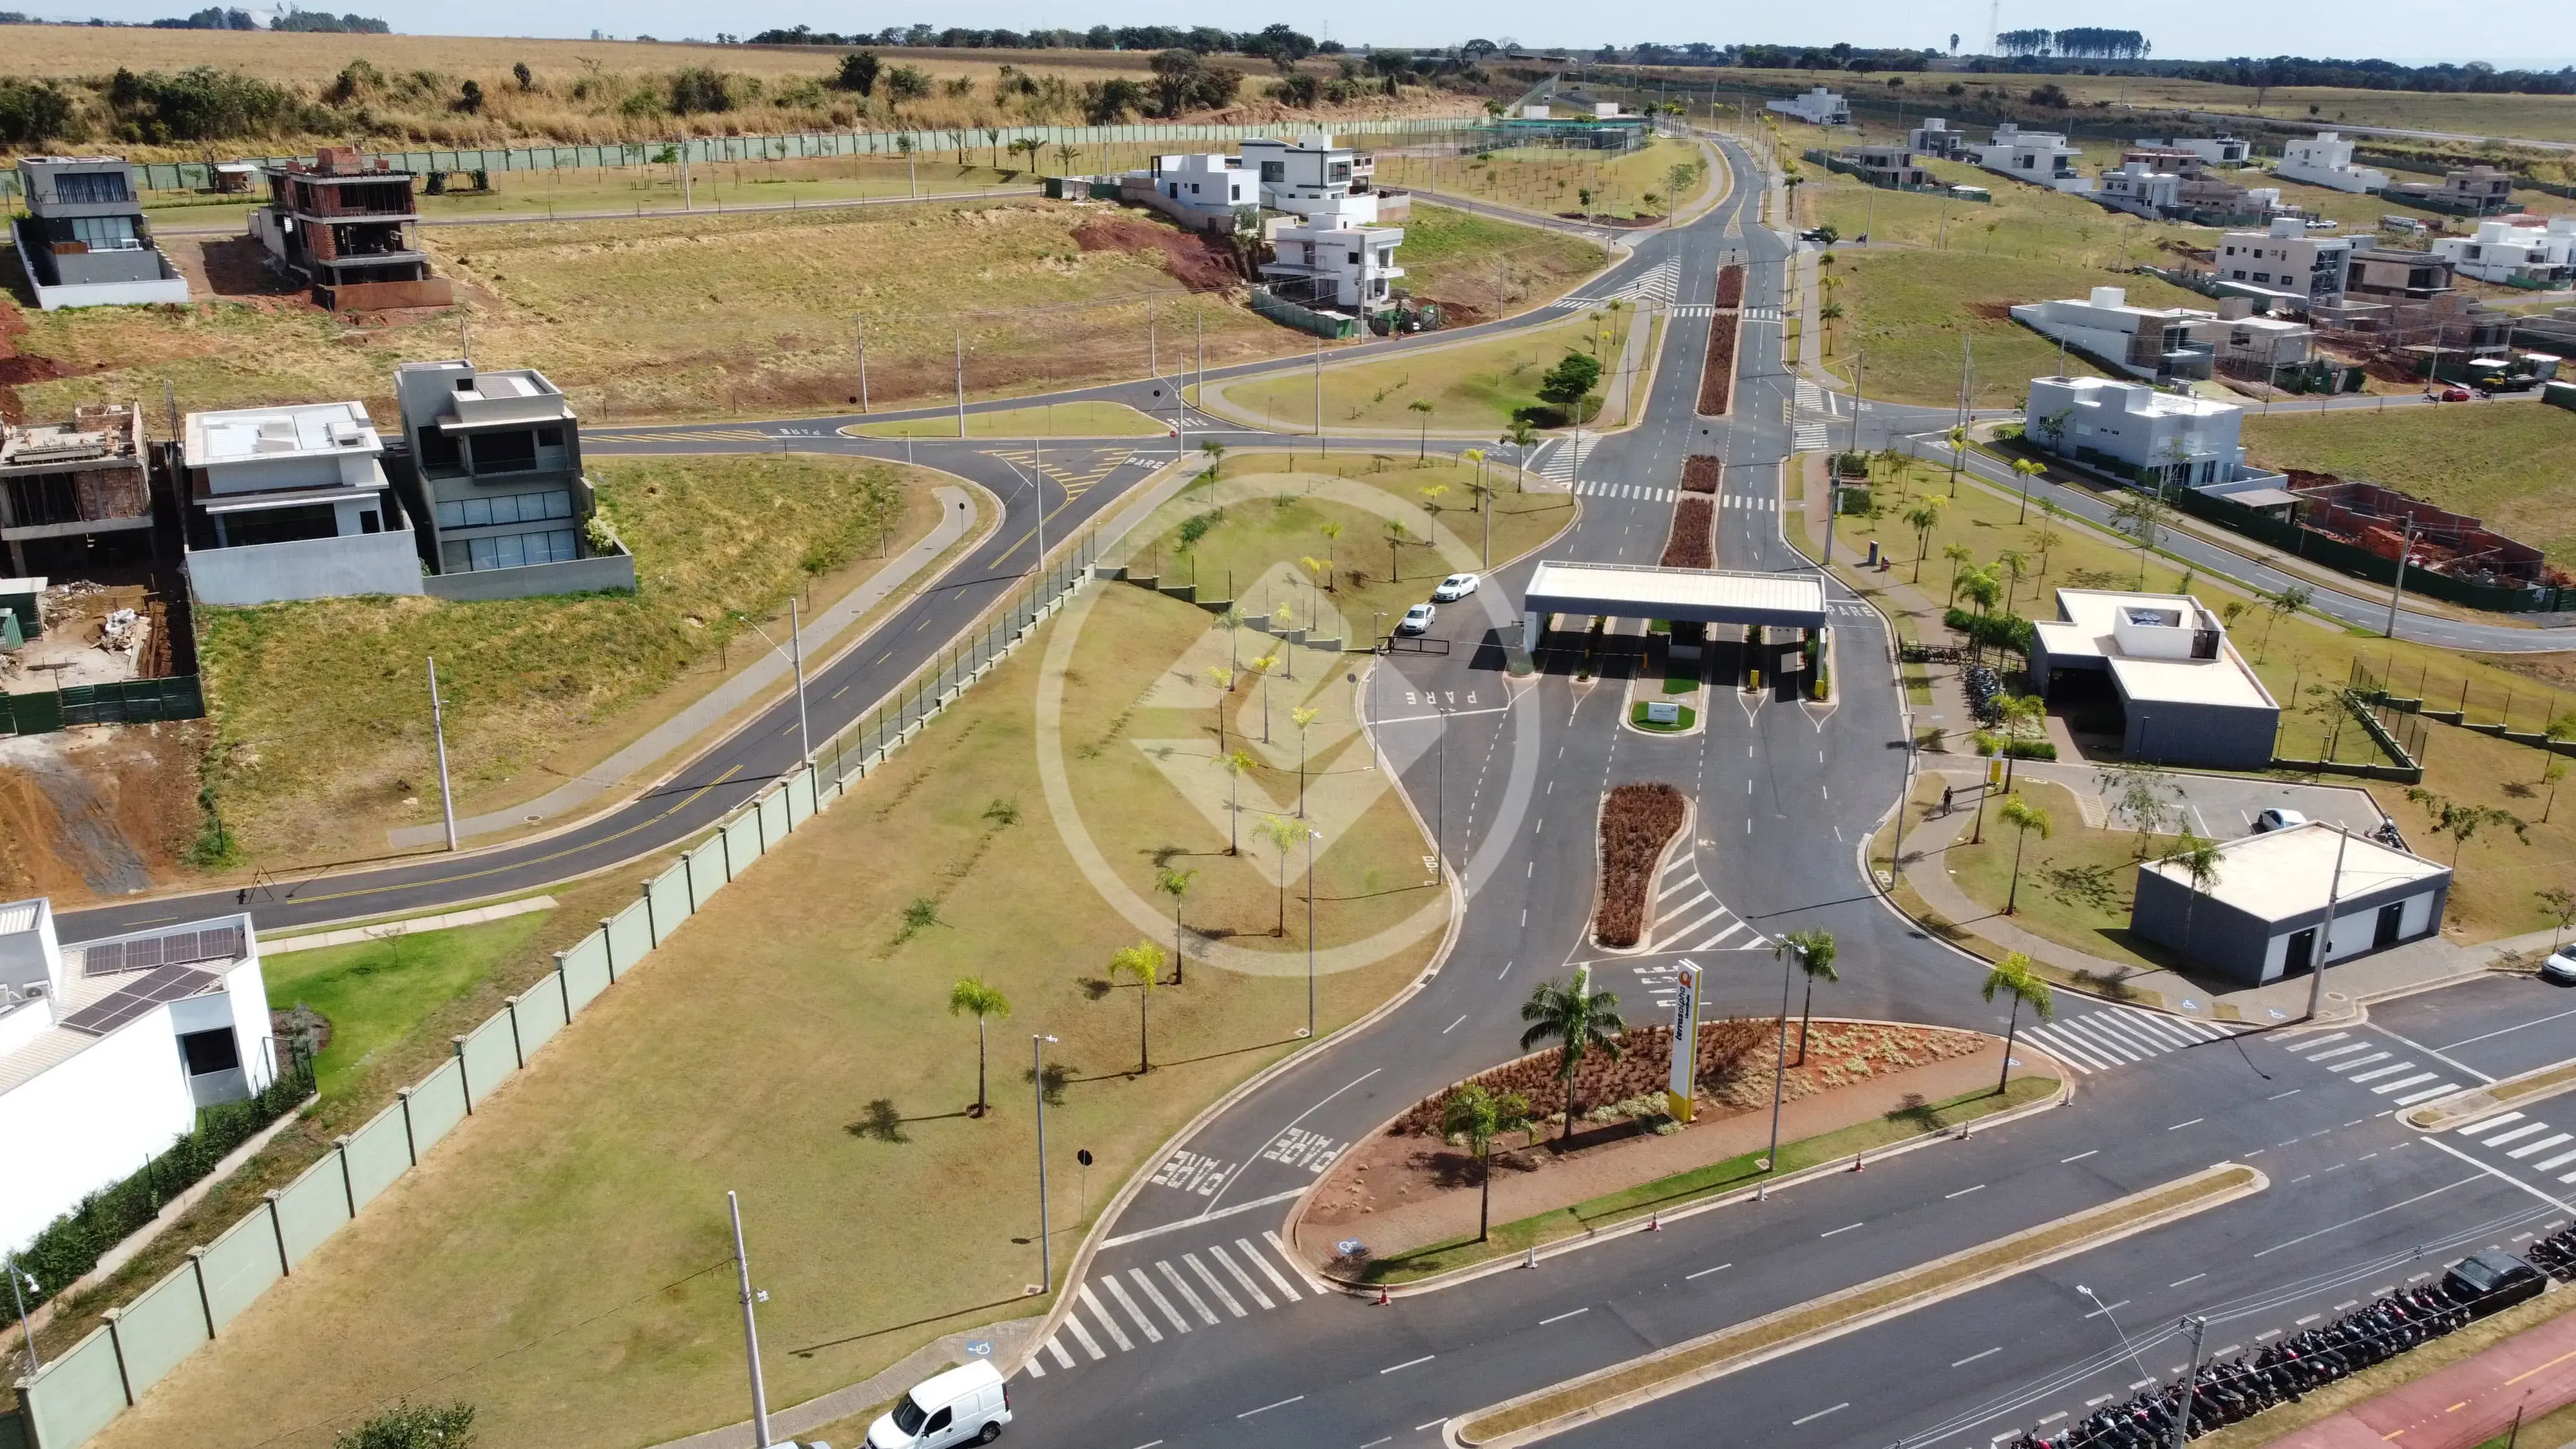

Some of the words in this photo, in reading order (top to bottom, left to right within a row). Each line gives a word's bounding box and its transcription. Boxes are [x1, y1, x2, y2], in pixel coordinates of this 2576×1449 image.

[1125, 457, 1165, 469] PARE
[1826, 605, 1875, 617] PARE
[1406, 690, 1477, 705] PARE
[1264, 1127, 1350, 1173] PARE
[1150, 1150, 1237, 1196] PARE
